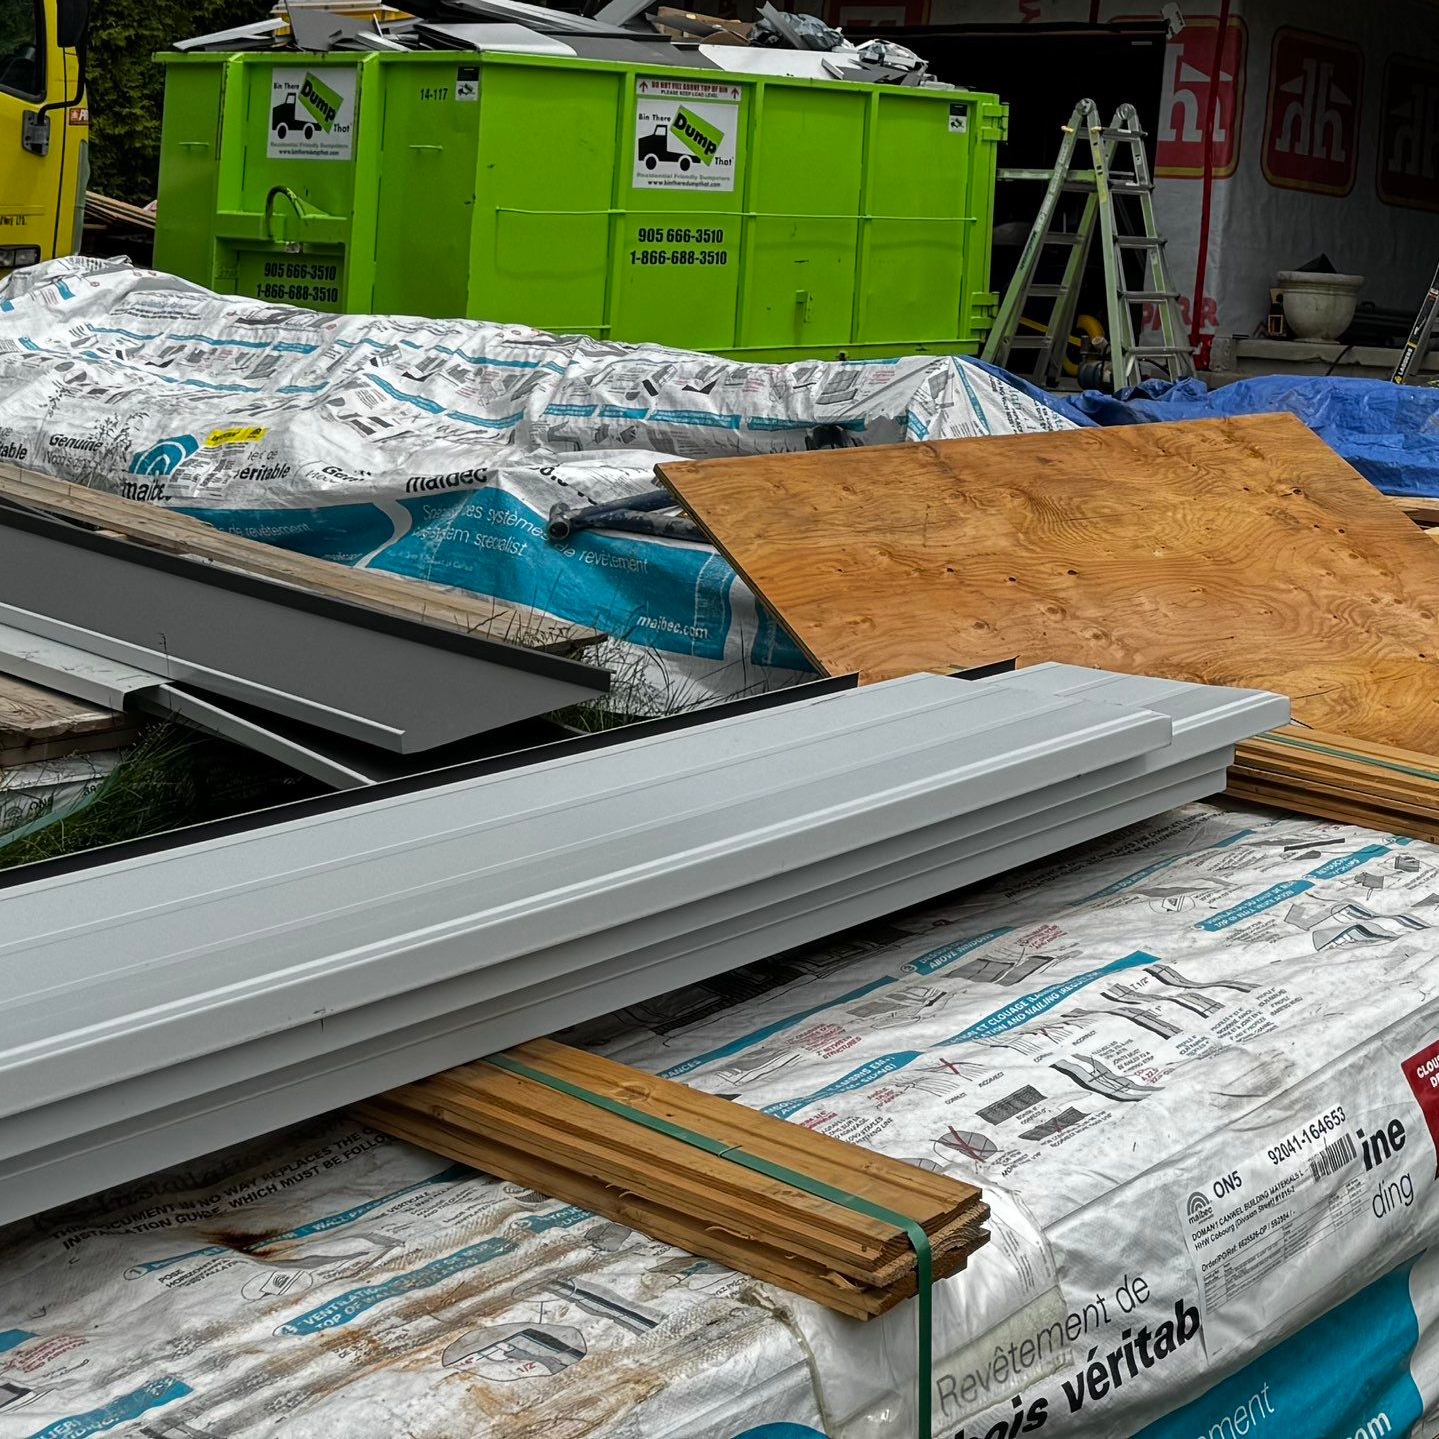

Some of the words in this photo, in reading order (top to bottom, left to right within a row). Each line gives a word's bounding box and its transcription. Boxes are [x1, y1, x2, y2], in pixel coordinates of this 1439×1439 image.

[274, 82, 282, 90] Bin
[284, 82, 300, 90] There
[420, 87, 448, 101] 14-117
[300, 78, 336, 122] Dump
[333, 122, 350, 133] That
[638, 113, 650, 121] Bin
[652, 114, 672, 122] There
[673, 112, 717, 155] Dump
[714, 156, 732, 166] That
[638, 228, 663, 244] 905
[665, 228, 724, 244] 666-3510
[629, 249, 727, 266] 1-866-688-3510
[264, 264, 285, 279] 905
[286, 265, 337, 281] 666-3510
[256, 283, 339, 303] 1-866-688-3510
[0, 442, 28, 460] table
[49, 433, 104, 452] Genuine
[636, 615, 708, 639] maibec.com
[929, 951, 958, 970] ABOVE
[988, 1001, 1029, 1026] CLOUAGE
[1026, 991, 1061, 1021] NAILING
[1213, 1170, 1242, 1199] ON5
[1267, 1105, 1346, 1165] 92041-164653
[198, 1194, 222, 1208] NO
[261, 1146, 333, 1183] REPLACES
[334, 1132, 362, 1151] THE
[62, 1216, 173, 1251] INSTALLATION
[228, 1183, 280, 1211] WHICH
[281, 1166, 321, 1189] MUST
[322, 1157, 344, 1171] BE
[343, 1133, 387, 1164] FOLLO
[1243, 1191, 1270, 1210] BUILDING
[1269, 1174, 1299, 1195] MATERIALS
[1372, 1172, 1414, 1219] ding
[1188, 1205, 1214, 1225] maibec
[1194, 1239, 1210, 1251] HHW
[1210, 1224, 1235, 1245] Cobourg
[936, 1293, 1112, 1417] Revêtement
[1114, 1273, 1151, 1315] de
[1061, 1298, 1202, 1414] véritab
[1196, 1381, 1275, 1439] ment
